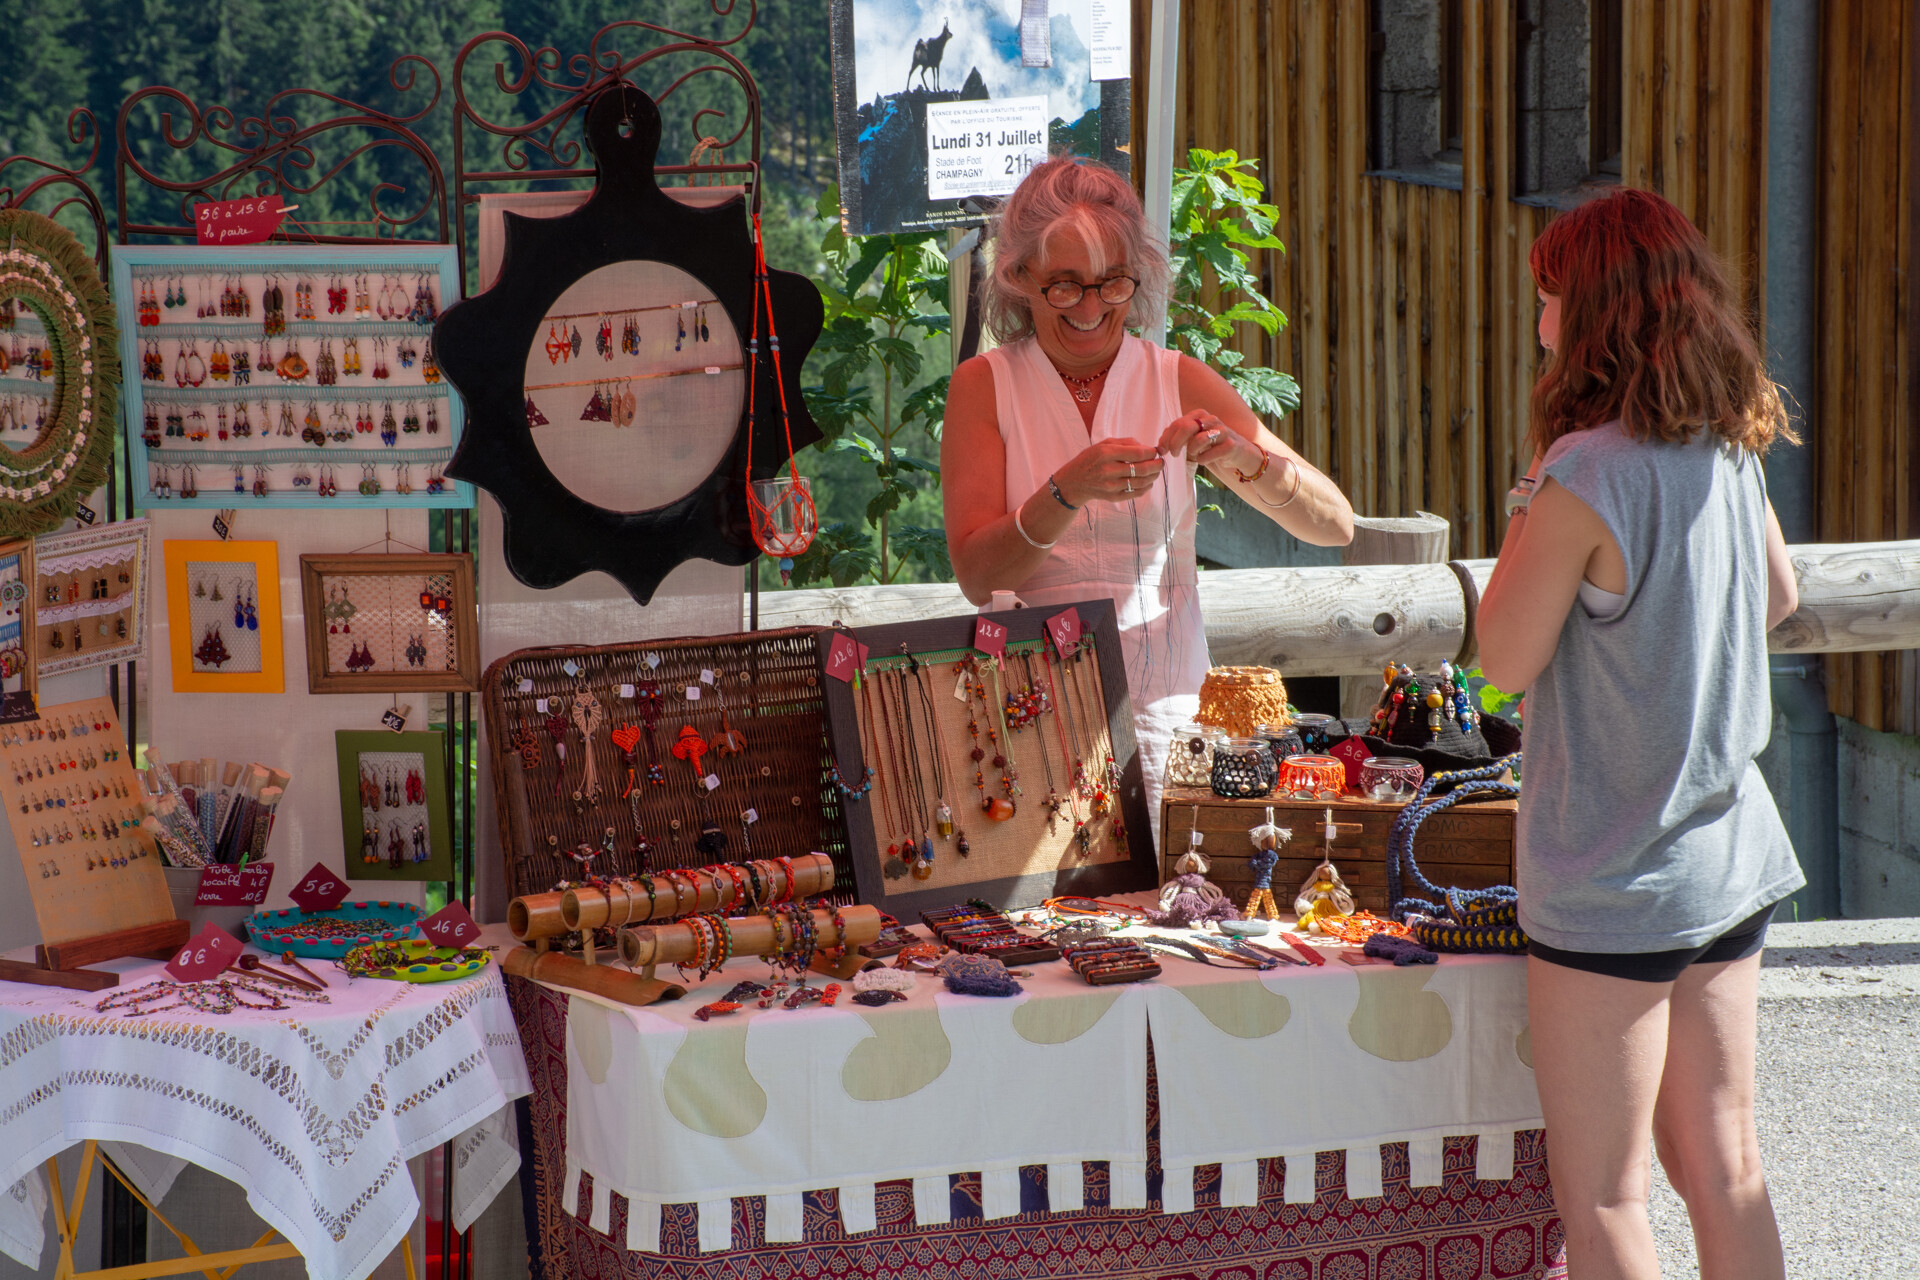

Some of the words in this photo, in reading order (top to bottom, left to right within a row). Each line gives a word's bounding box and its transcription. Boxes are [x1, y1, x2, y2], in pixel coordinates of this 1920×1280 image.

[932, 133, 971, 150] Lundi
[976, 131, 991, 148] 31
[997, 129, 1042, 146] Juillet
[935, 156, 955, 167] Stade
[956, 157, 965, 166] de
[966, 155, 982, 165] Foot
[1004, 153, 1033, 175] 21h
[936, 168, 984, 180] CHAMPAGNY
[219, 225, 254, 243] paire
[1427, 818, 1470, 834] DMC
[1424, 842, 1468, 858] DMC
[198, 892, 223, 901] verre
